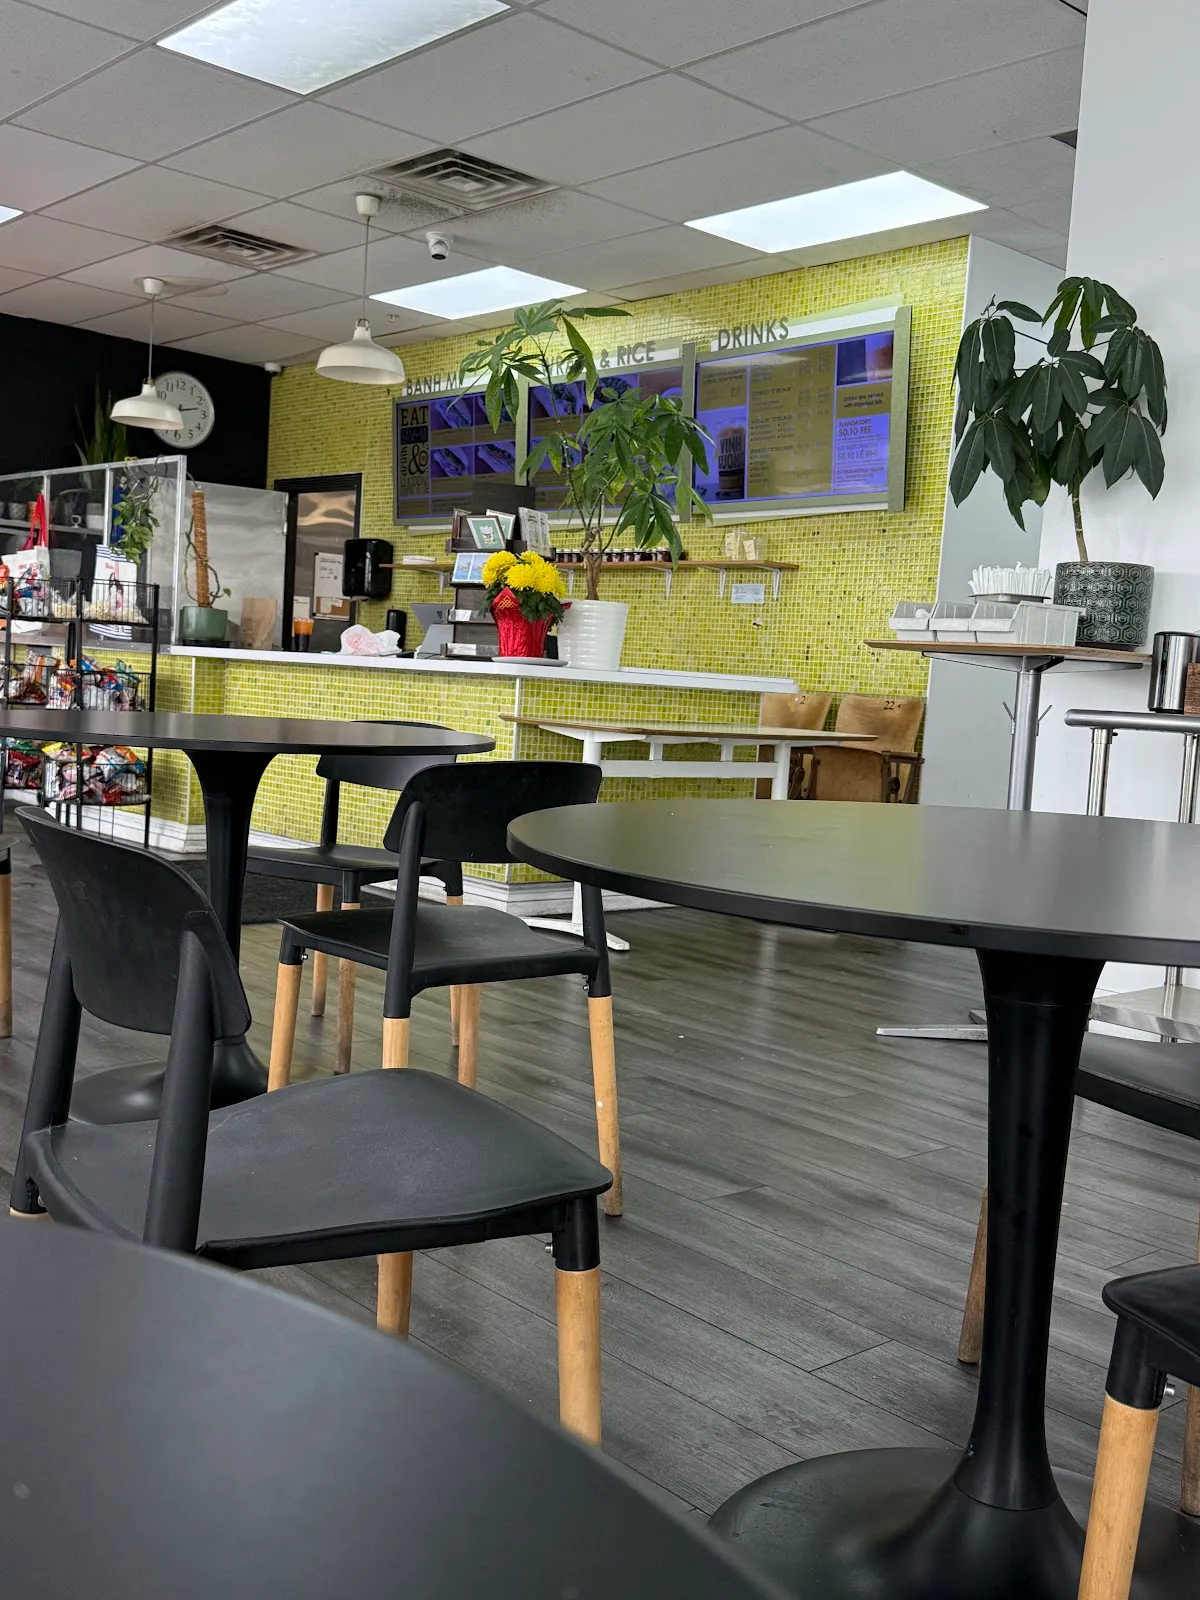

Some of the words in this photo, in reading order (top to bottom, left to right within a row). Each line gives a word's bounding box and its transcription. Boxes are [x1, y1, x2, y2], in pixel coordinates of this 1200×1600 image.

[718, 316, 789, 351] DRINKS
[600, 349, 611, 369] &
[617, 341, 656, 366] RICE
[166, 381, 174, 392] 11
[176, 378, 186, 391] 12
[407, 375, 441, 395] BANH
[201, 410, 208, 420] 3
[400, 405, 428, 427] EAT
[188, 429, 194, 440] 5
[839, 428, 858, 437] $0.10
[860, 425, 872, 434] FEE
[883, 700, 895, 710] 22
